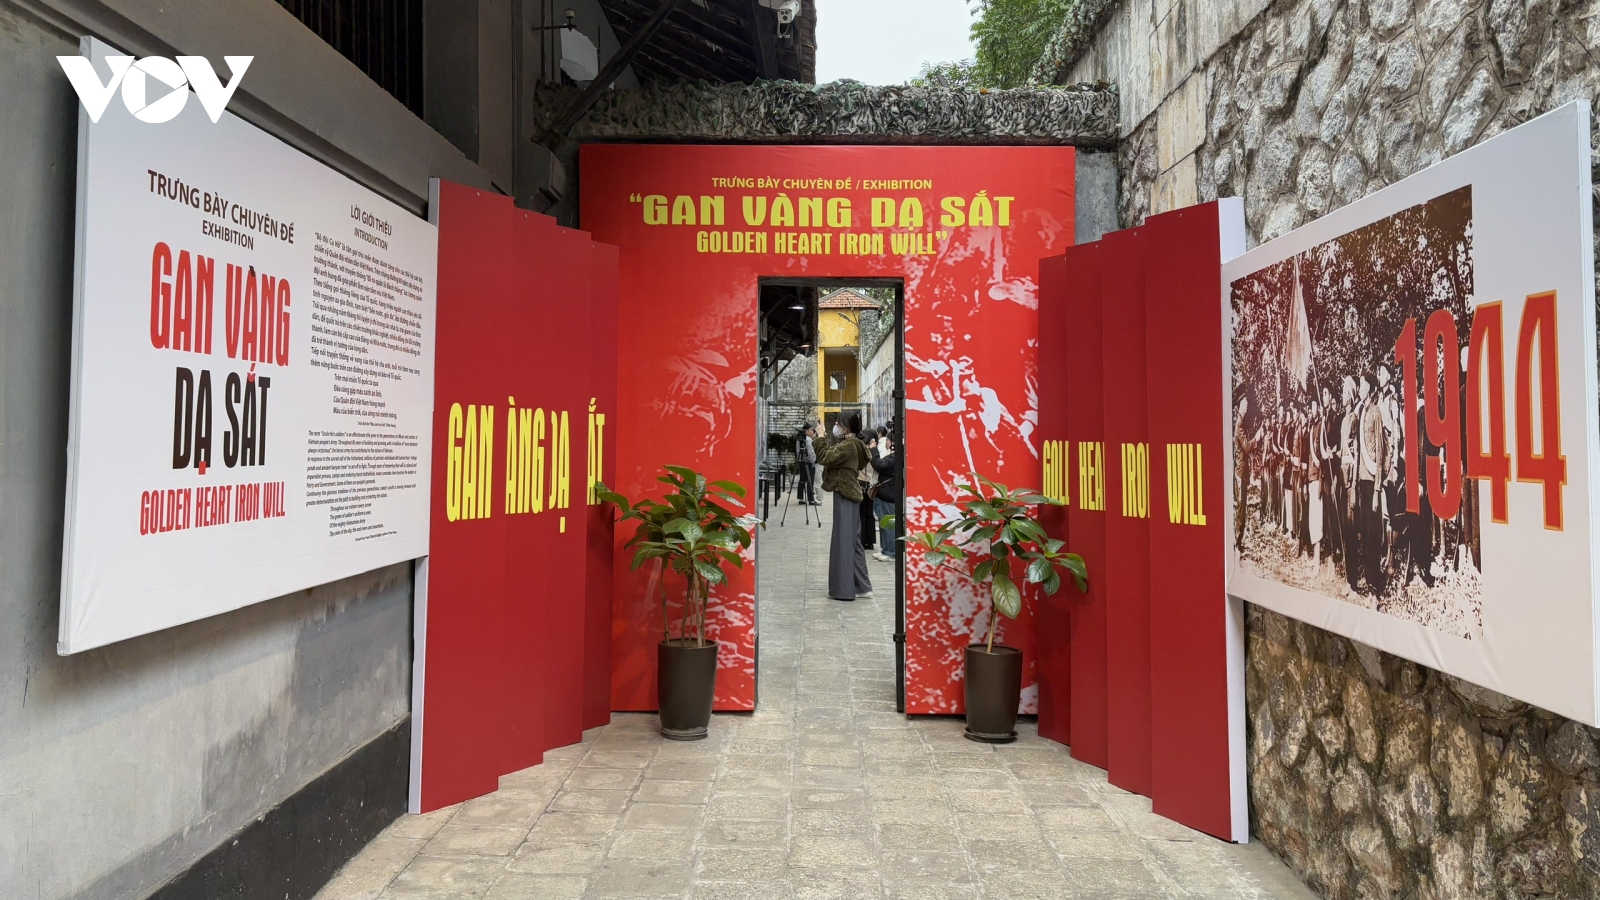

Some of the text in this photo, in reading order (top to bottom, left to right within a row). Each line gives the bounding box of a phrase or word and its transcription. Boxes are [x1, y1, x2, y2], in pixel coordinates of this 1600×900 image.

[148, 169, 294, 244] TRƯNG BÀY CHUYÊN ĐỀ
[629, 190, 1014, 231] “GAN VÀNG DẠ SẮT
[711, 177, 754, 190] TRƯNG
[757, 176, 781, 190] BÀY
[783, 176, 833, 190] CHUYÊN
[835, 176, 852, 190] ĐỀ
[863, 179, 932, 190] EXHIBITION
[202, 220, 254, 250] EXHIBITION
[351, 204, 392, 238] LỜI GIỚI THIỆU
[354, 227, 388, 251] INTRODUCTION
[697, 231, 948, 255] GOLDEN HEART IRON WILL”
[150, 241, 291, 366] GAN VÀNG
[172, 363, 271, 475] DẠ SẮT
[1395, 288, 1567, 532] 1944
[446, 402, 494, 522] GAN
[1167, 443, 1207, 526] WILL
[140, 481, 286, 536] GOLDEN HEART IRON WILL
